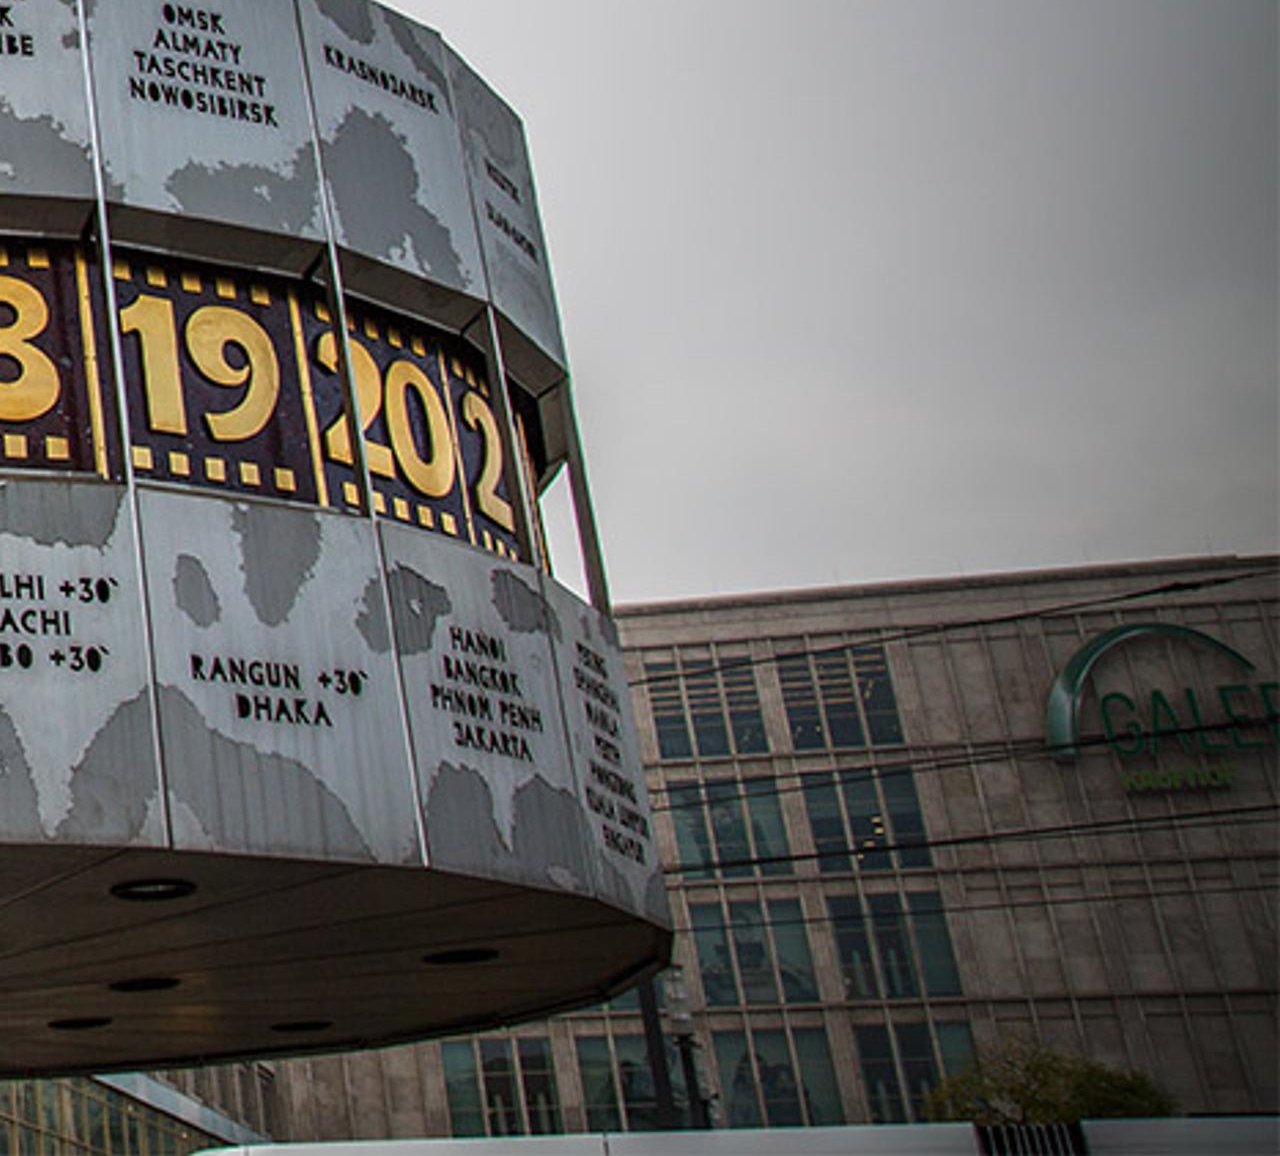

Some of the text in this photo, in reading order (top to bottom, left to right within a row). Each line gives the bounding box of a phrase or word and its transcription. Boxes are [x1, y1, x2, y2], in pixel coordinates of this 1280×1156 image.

[163, 3, 225, 35] OMSK
[153, 28, 241, 65] ALMATY
[134, 50, 265, 97] TASCHKENT
[129, 76, 278, 128] NOWOSIBIRSK
[120, 294, 280, 442] 19
[317, 331, 455, 497] 20
[450, 626, 506, 662] HANOI
[191, 655, 300, 690] RANGUN
[444, 655, 522, 696] BANGKOK
[236, 693, 332, 727] DHAKA
[430, 684, 543, 732] PHNOM PENH
[454, 721, 533, 762] JAKARTA
